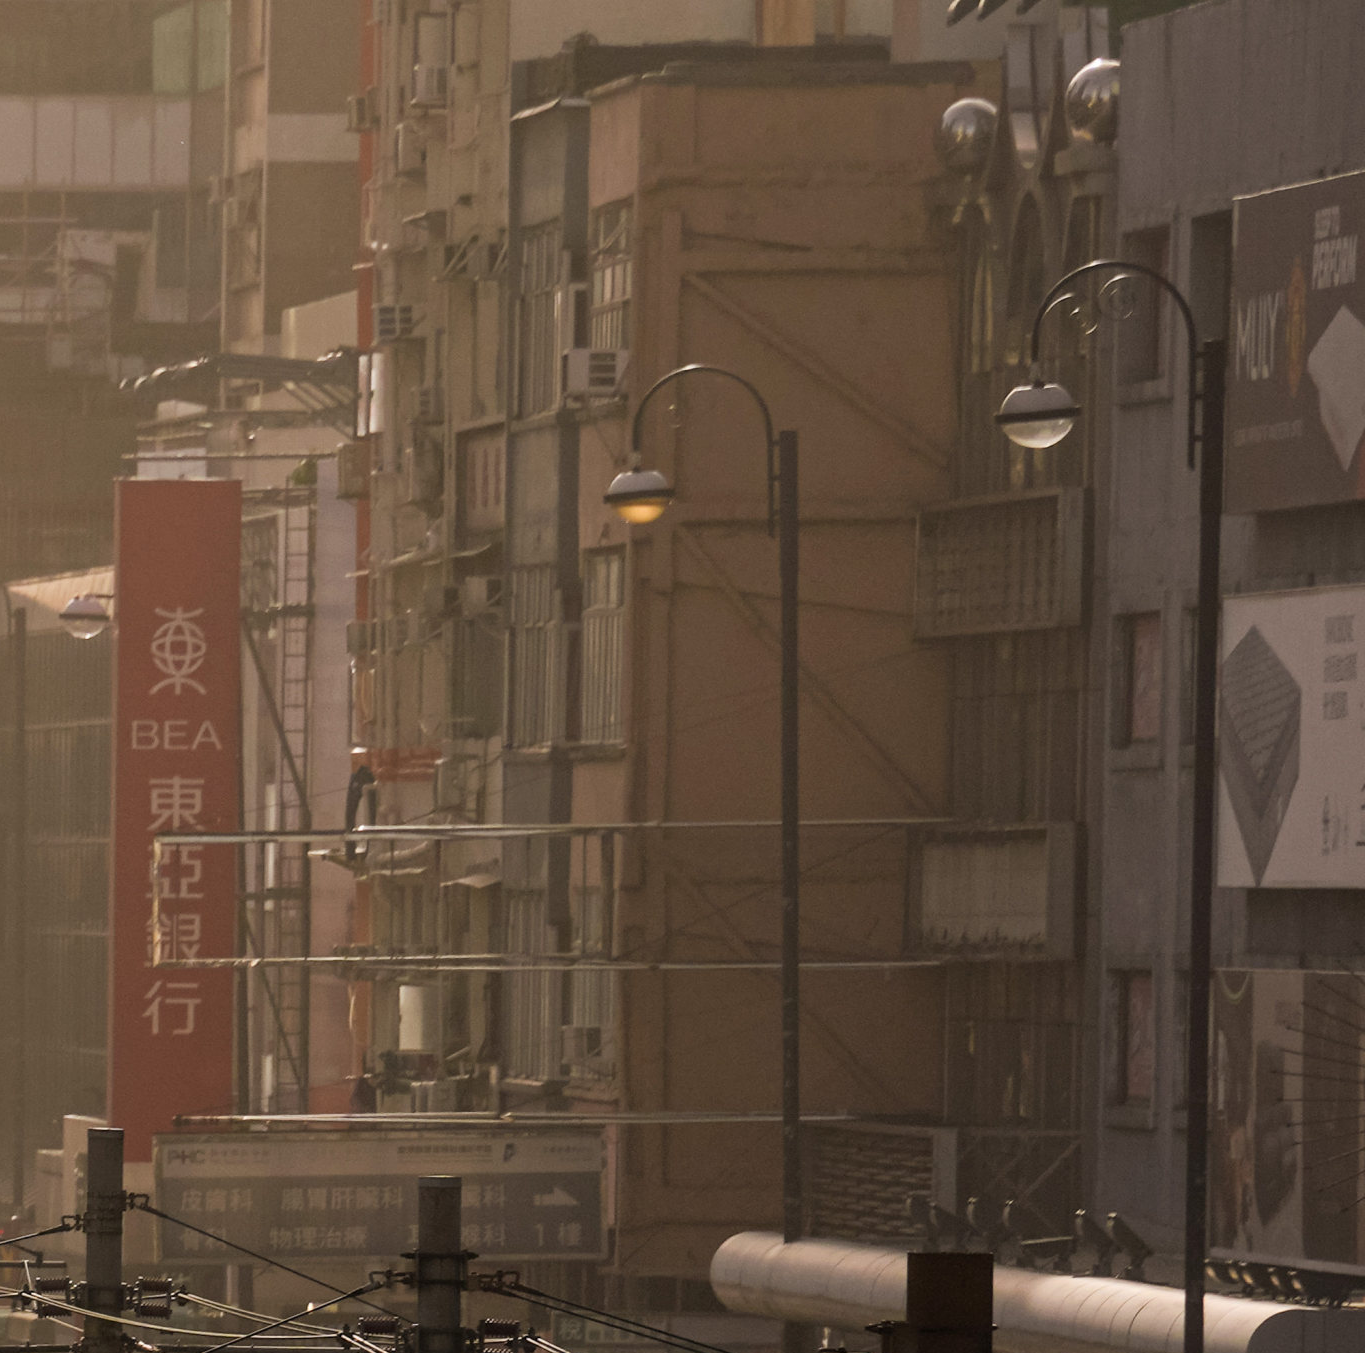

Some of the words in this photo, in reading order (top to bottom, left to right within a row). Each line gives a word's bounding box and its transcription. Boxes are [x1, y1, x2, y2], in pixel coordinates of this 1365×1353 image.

[132, 721, 221, 751] BEA
[141, 777, 206, 1037] 東亞銀行
